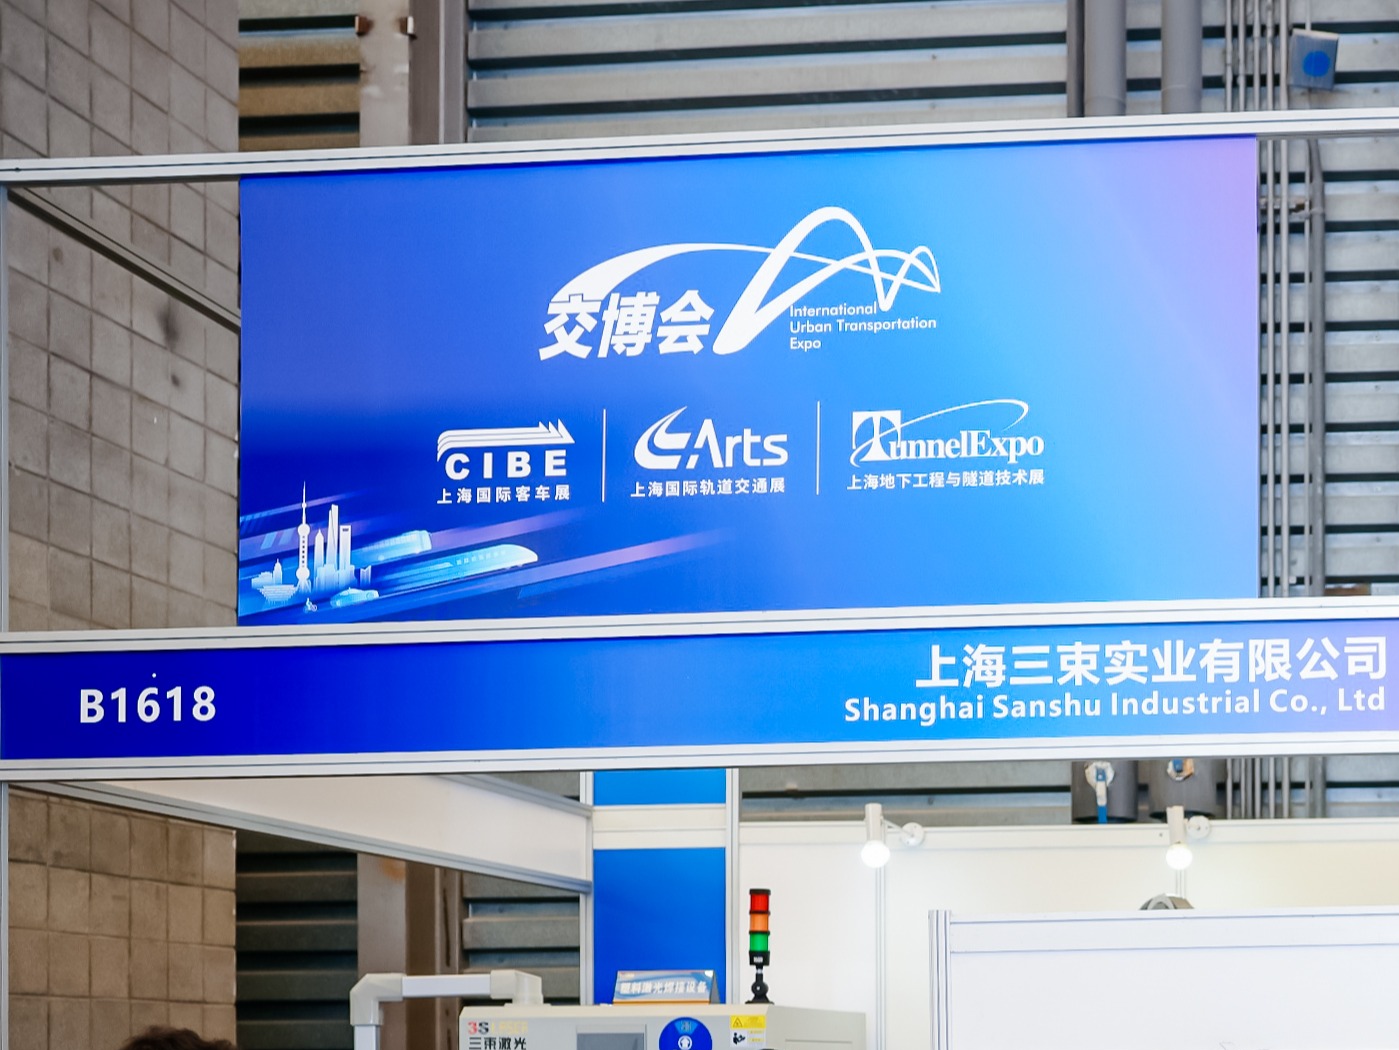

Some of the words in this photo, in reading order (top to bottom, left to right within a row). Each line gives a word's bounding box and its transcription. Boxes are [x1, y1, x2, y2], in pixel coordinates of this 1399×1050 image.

[789, 301, 877, 317] International
[538, 289, 715, 361] 交博会
[789, 319, 833, 334] Urban
[836, 316, 937, 334] Transportation
[789, 337, 822, 352] Expo
[444, 450, 568, 480] CIBE
[630, 477, 786, 499] 上海国际轨道交通展
[846, 469, 1046, 491] 上海地下工程与隧道技术展
[436, 484, 571, 505] 上海国际客车展
[914, 635, 1389, 688] 上海三束实业有限公司
[79, 685, 217, 724] B1618
[843, 694, 985, 727] Shanghai
[992, 692, 1102, 719] Sanshu
[1110, 688, 1260, 717] Industrial
[1268, 688, 1328, 716] Co.,
[1337, 686, 1386, 713] Ltd
